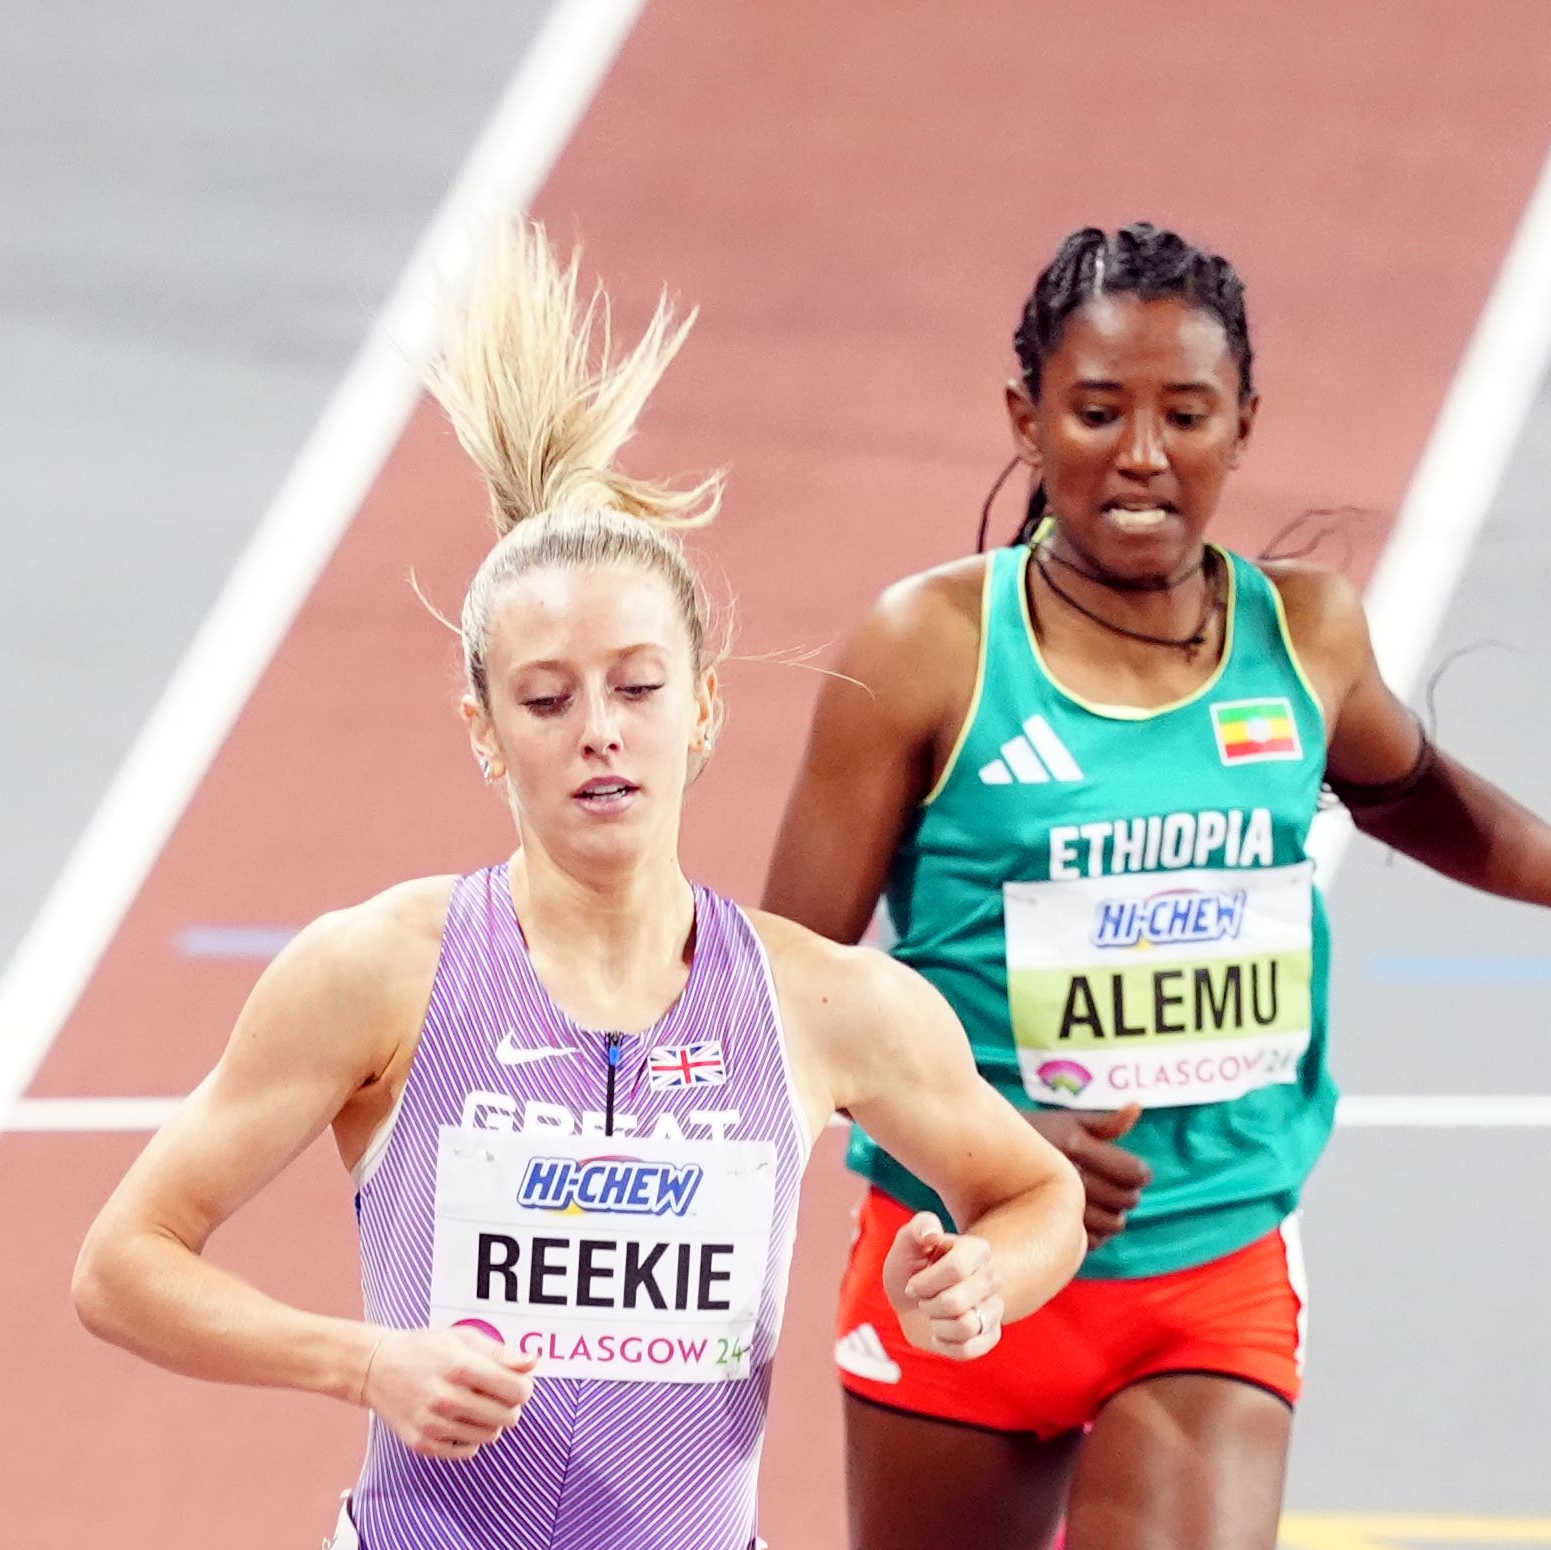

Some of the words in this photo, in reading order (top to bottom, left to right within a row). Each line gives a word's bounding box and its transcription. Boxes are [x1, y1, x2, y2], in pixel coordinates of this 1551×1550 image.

[1050, 808, 1274, 880] ETHIOPIA
[1092, 889, 1248, 948] HI-CHEW
[1058, 960, 1279, 1041] ALEMU
[518, 1157, 703, 1216] HI-CHEW
[476, 1233, 735, 1311] REEKIE
[519, 1332, 708, 1364] GLASGOW
